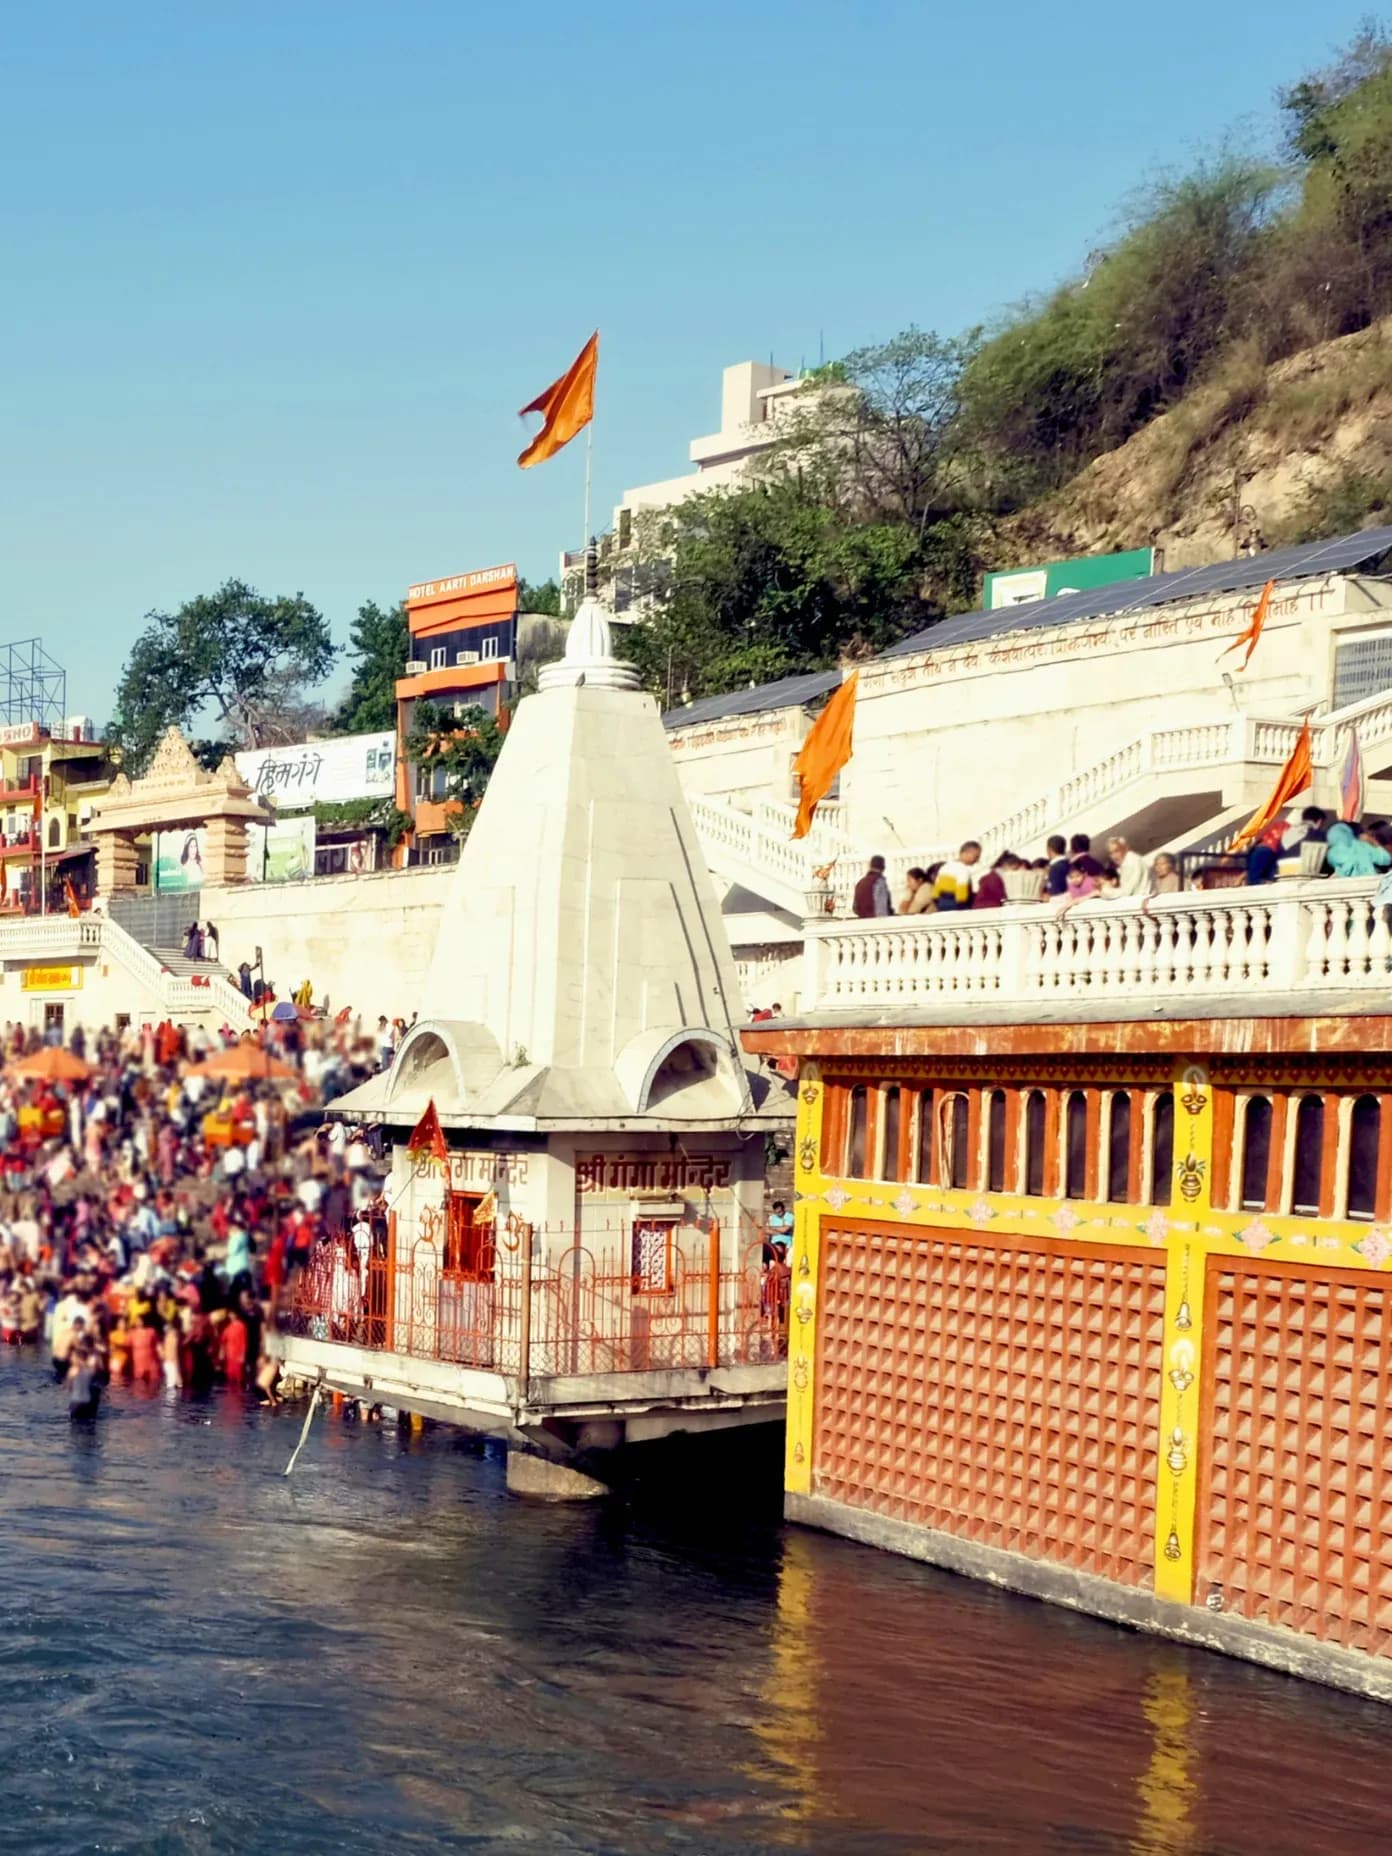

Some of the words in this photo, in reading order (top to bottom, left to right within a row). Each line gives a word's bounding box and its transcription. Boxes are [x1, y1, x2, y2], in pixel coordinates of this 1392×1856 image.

[409, 584, 436, 599] HOTEL
[440, 578, 467, 593] AARTI
[470, 566, 514, 586] DARSHAN
[576, 1154, 607, 1194] श्री
[610, 1154, 658, 1192] गंगा
